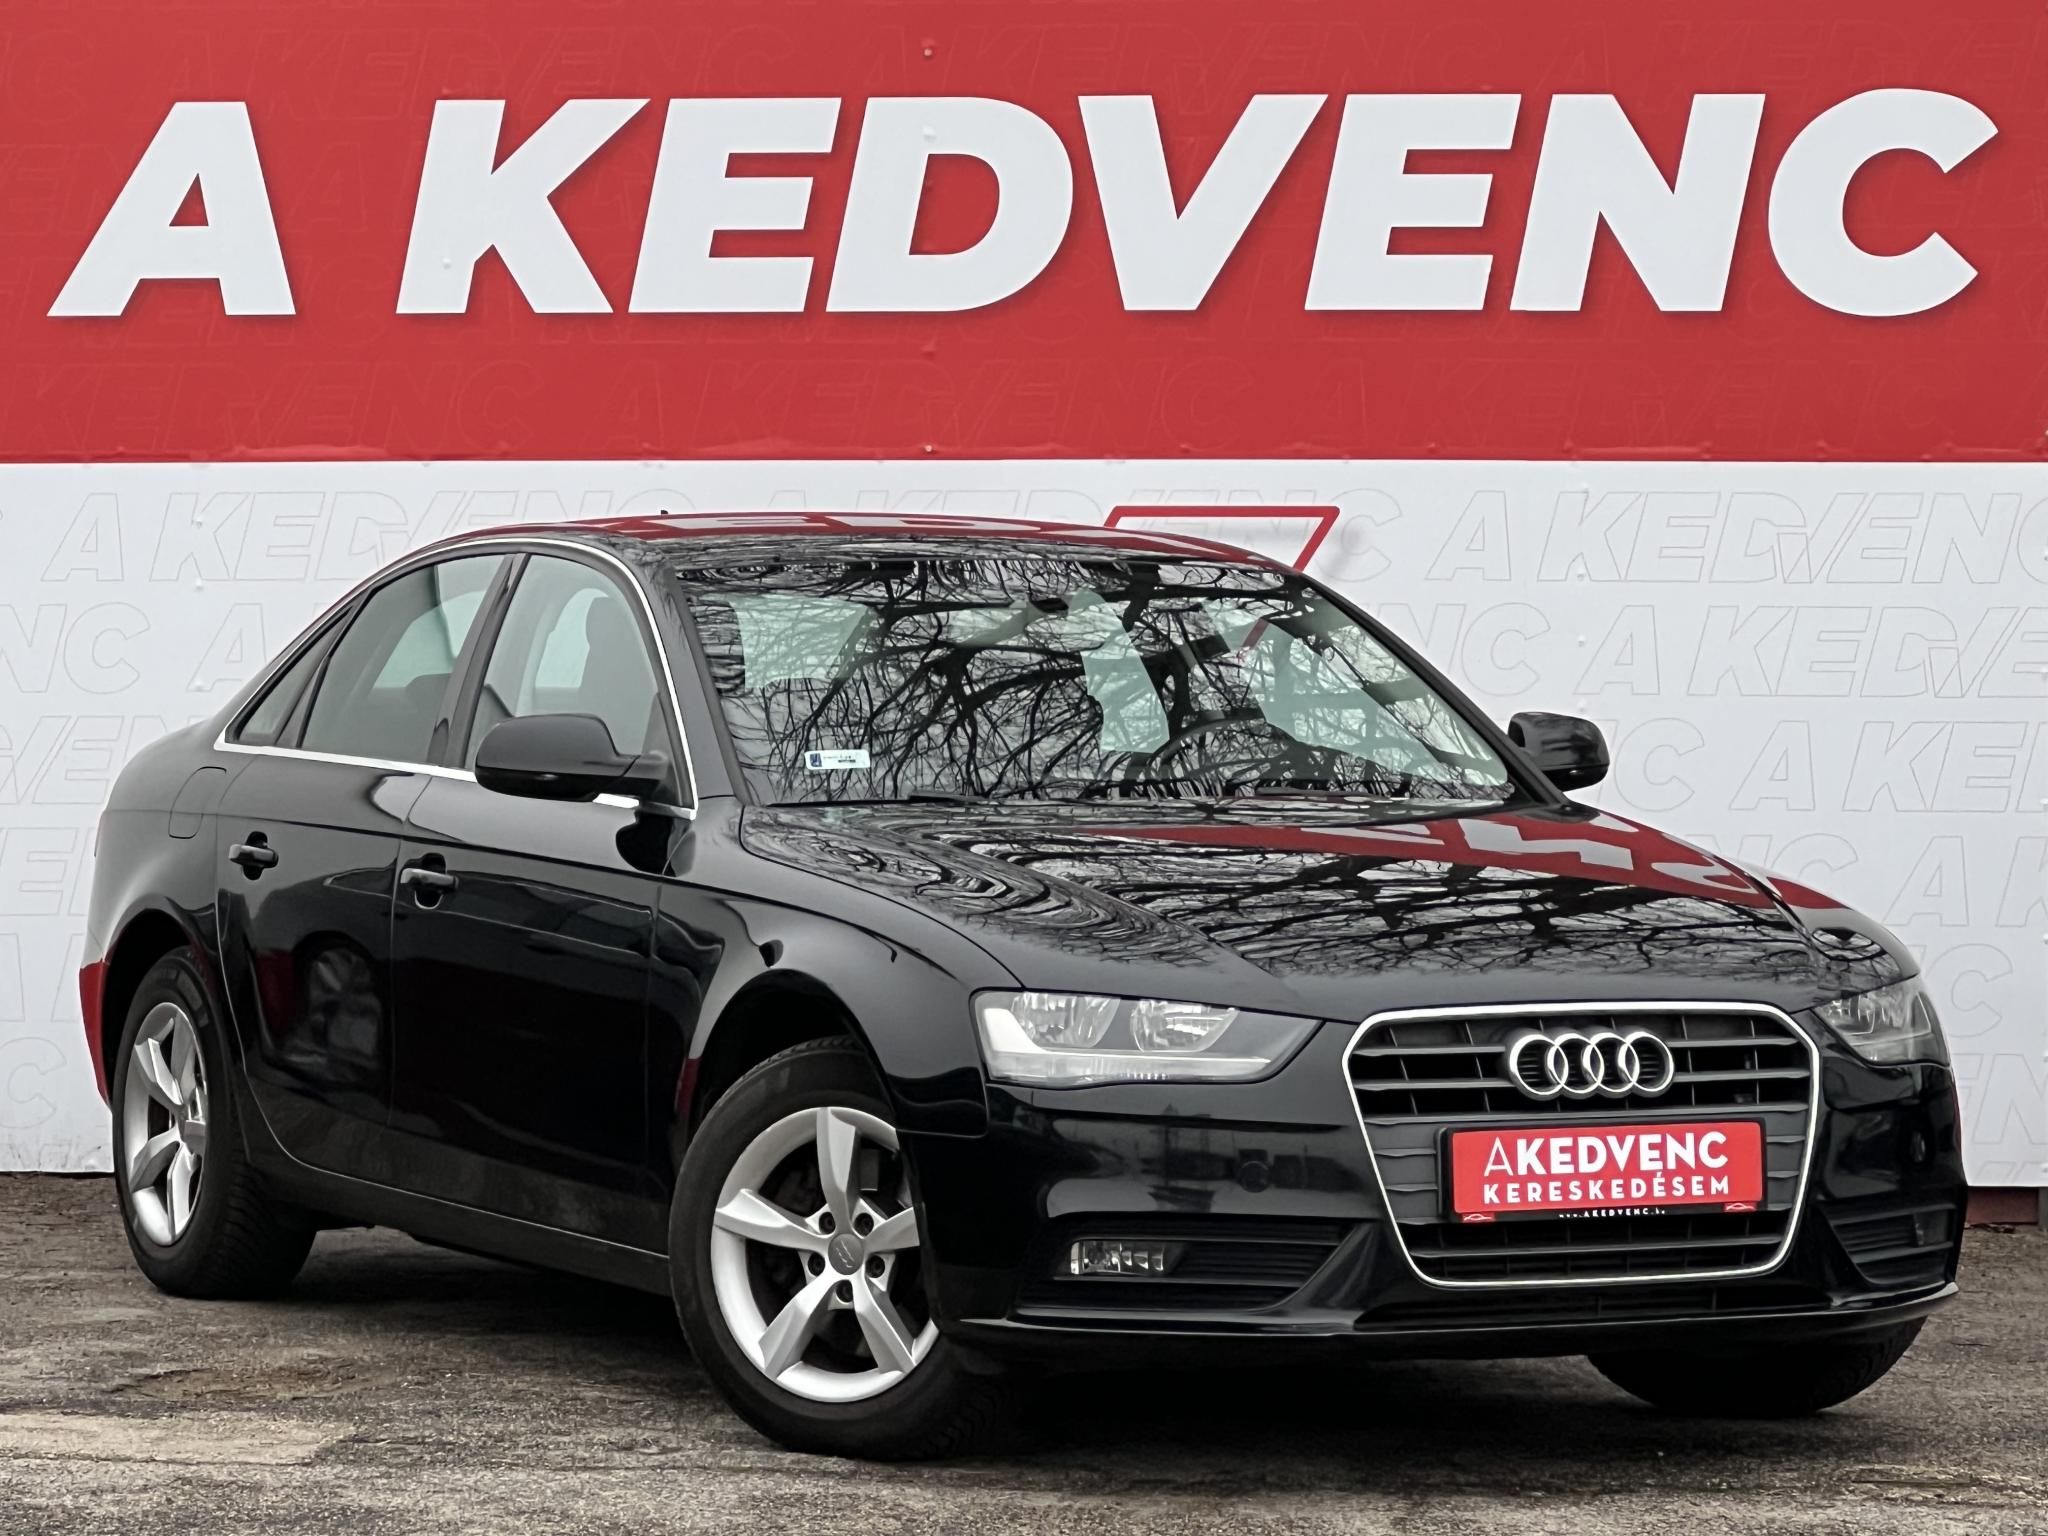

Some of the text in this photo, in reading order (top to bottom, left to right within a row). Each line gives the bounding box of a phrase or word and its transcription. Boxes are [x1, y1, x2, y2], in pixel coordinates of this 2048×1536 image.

[48, 101, 297, 318] A
[396, 88, 2000, 318] KEDVENC
[1483, 1172, 1730, 1204] KERESKEDÉSEM
